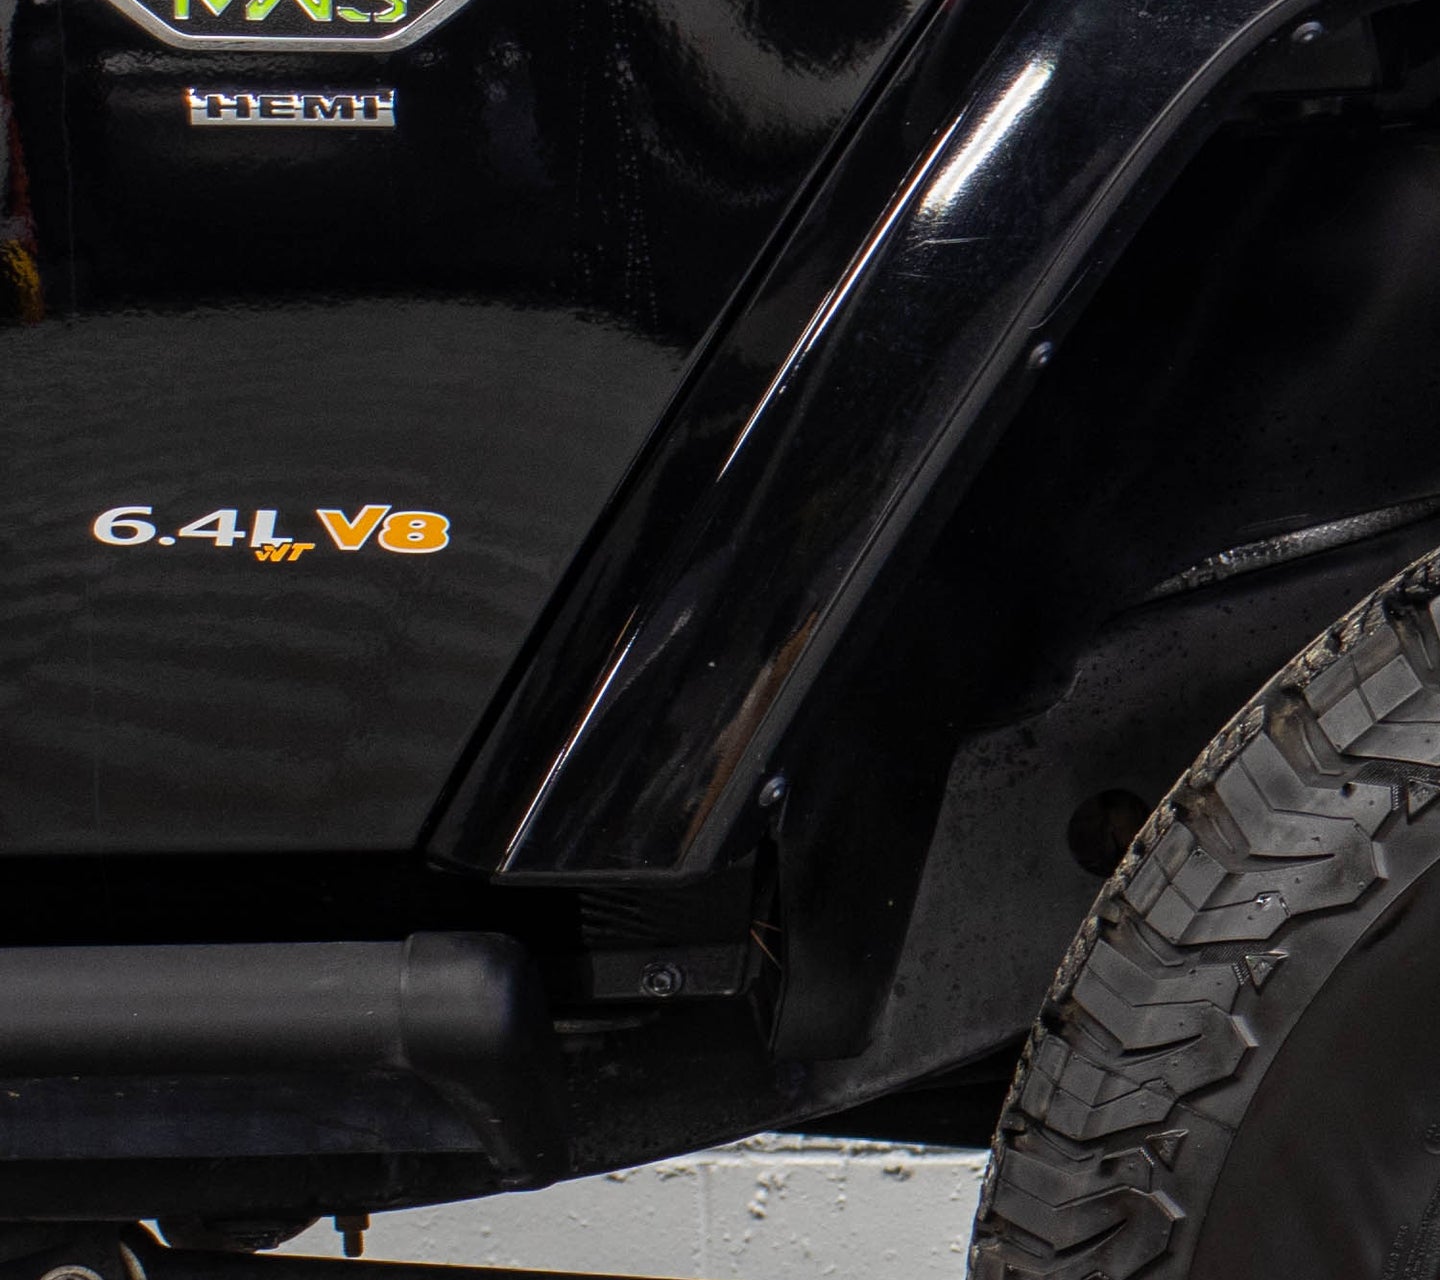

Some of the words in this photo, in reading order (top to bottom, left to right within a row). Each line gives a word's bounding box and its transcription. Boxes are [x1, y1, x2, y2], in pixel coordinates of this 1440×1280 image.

[206, 95, 381, 120] HEMI
[93, 505, 293, 547] 6.4L
[317, 504, 450, 553] V8
